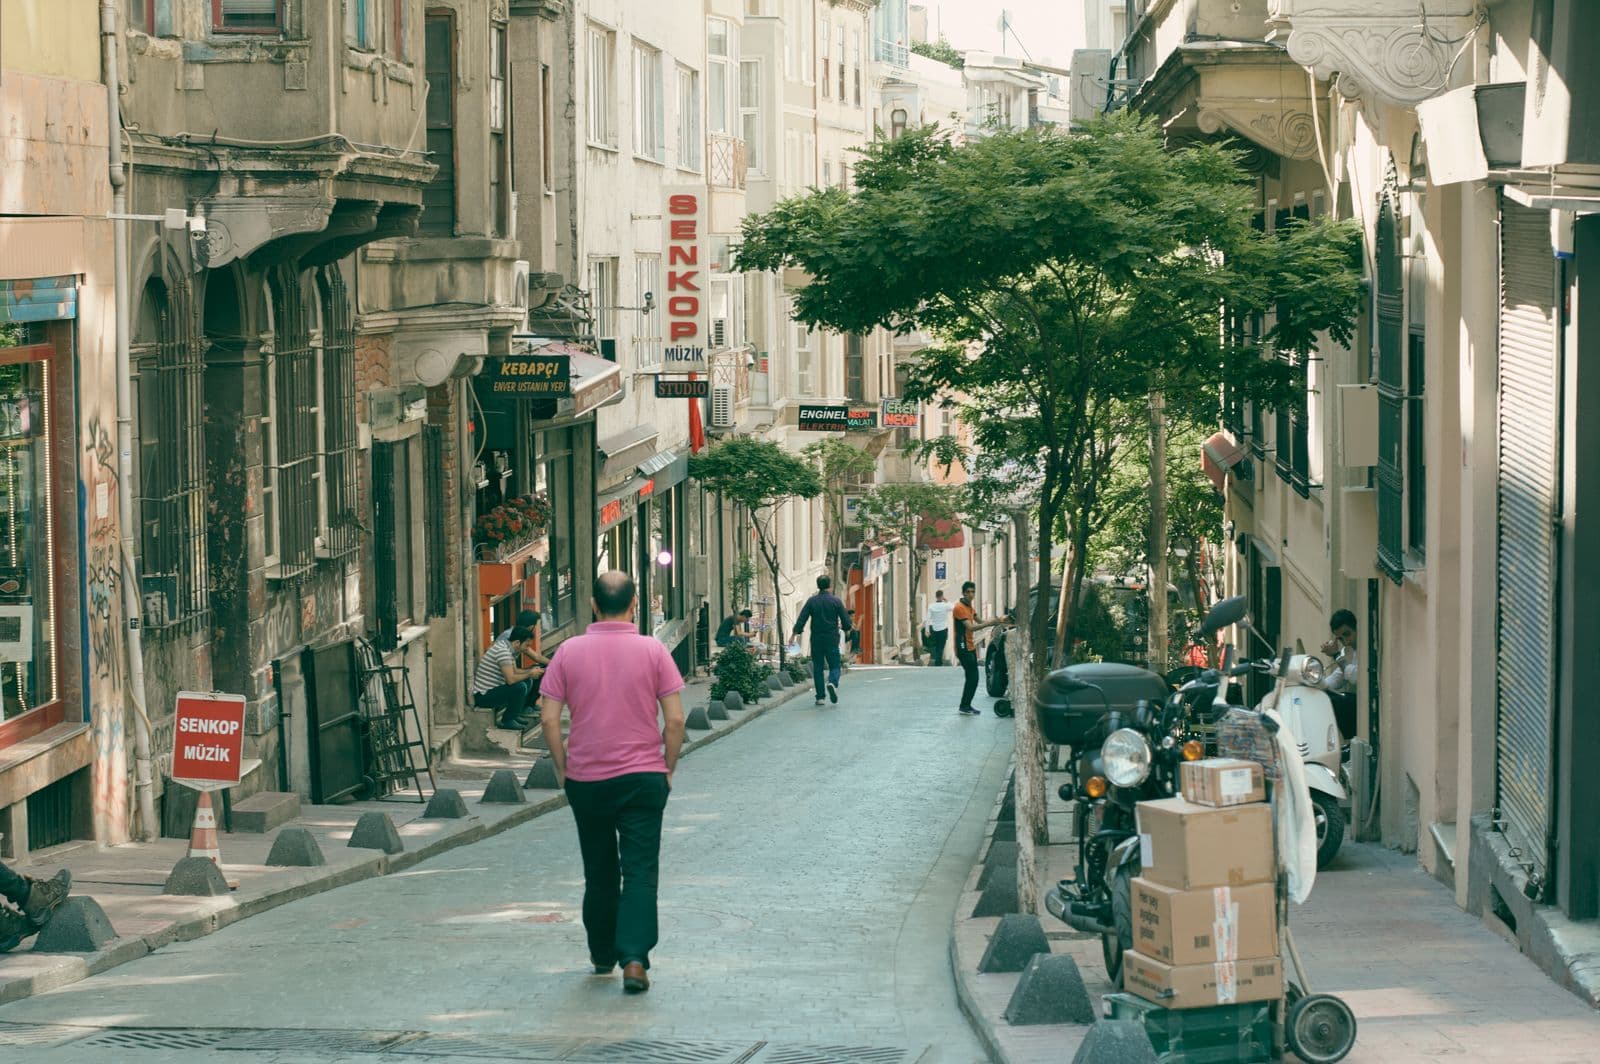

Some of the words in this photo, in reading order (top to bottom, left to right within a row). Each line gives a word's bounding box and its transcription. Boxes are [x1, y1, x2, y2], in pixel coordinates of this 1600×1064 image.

[668, 194, 700, 342] SENKOP
[665, 344, 704, 361] MÜZİK
[501, 362, 559, 379] KEBAPÇI
[493, 381, 517, 392] ENVER
[658, 382, 707, 396] STUDIO
[800, 407, 848, 420] ENGİNEL
[848, 410, 870, 419] NEON
[886, 413, 918, 426] NEON
[179, 717, 240, 736] SENKOP
[183, 744, 231, 762] MÜZİK
